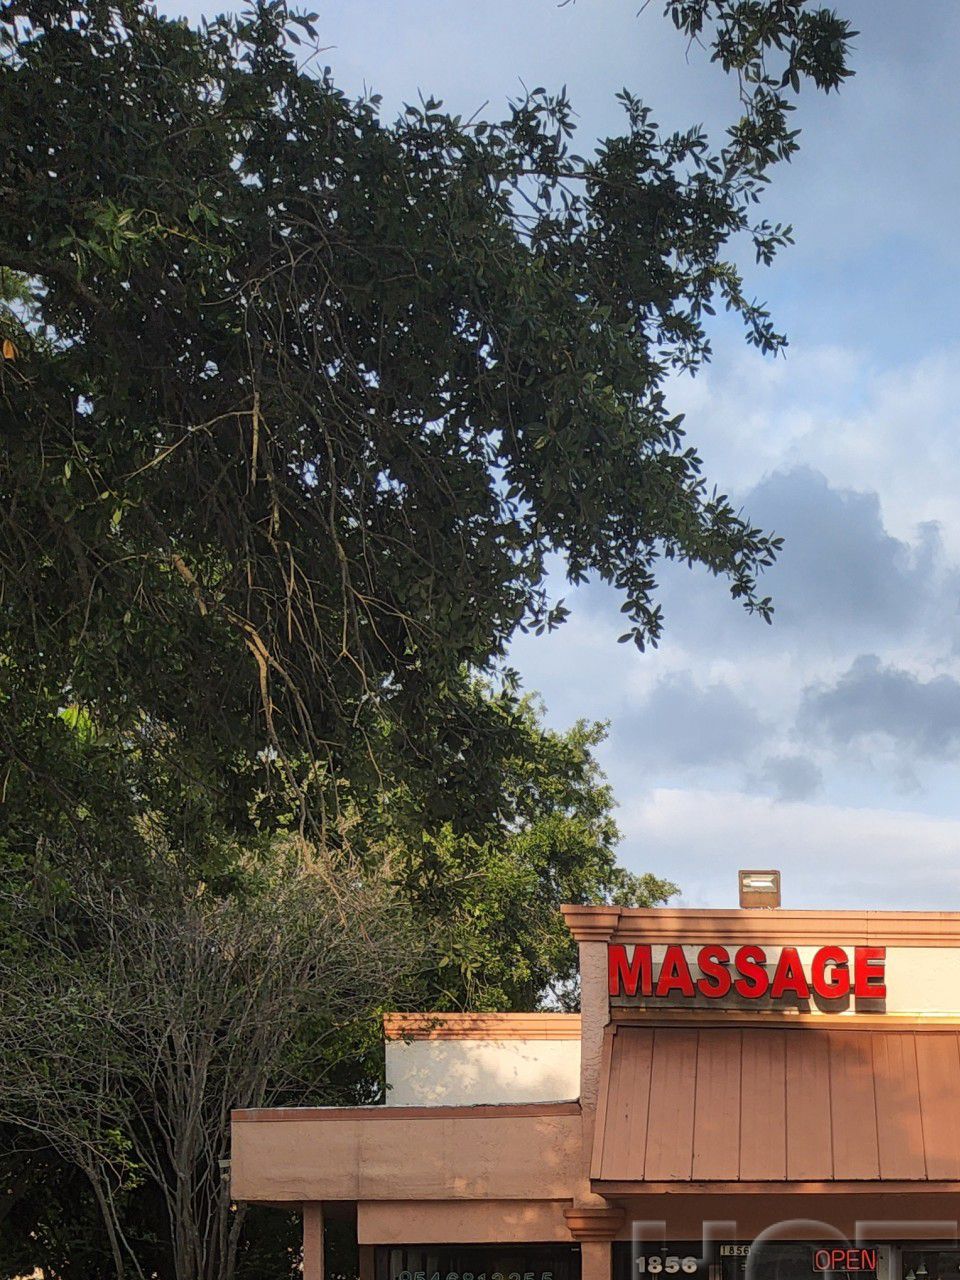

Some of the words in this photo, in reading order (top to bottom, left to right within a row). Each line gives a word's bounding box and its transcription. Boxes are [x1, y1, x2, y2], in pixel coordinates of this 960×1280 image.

[608, 944, 886, 999] MASSAGE
[722, 1246, 749, 1256] 1856
[816, 1249, 877, 1270] OPEN
[636, 1256, 698, 1274] 1856
